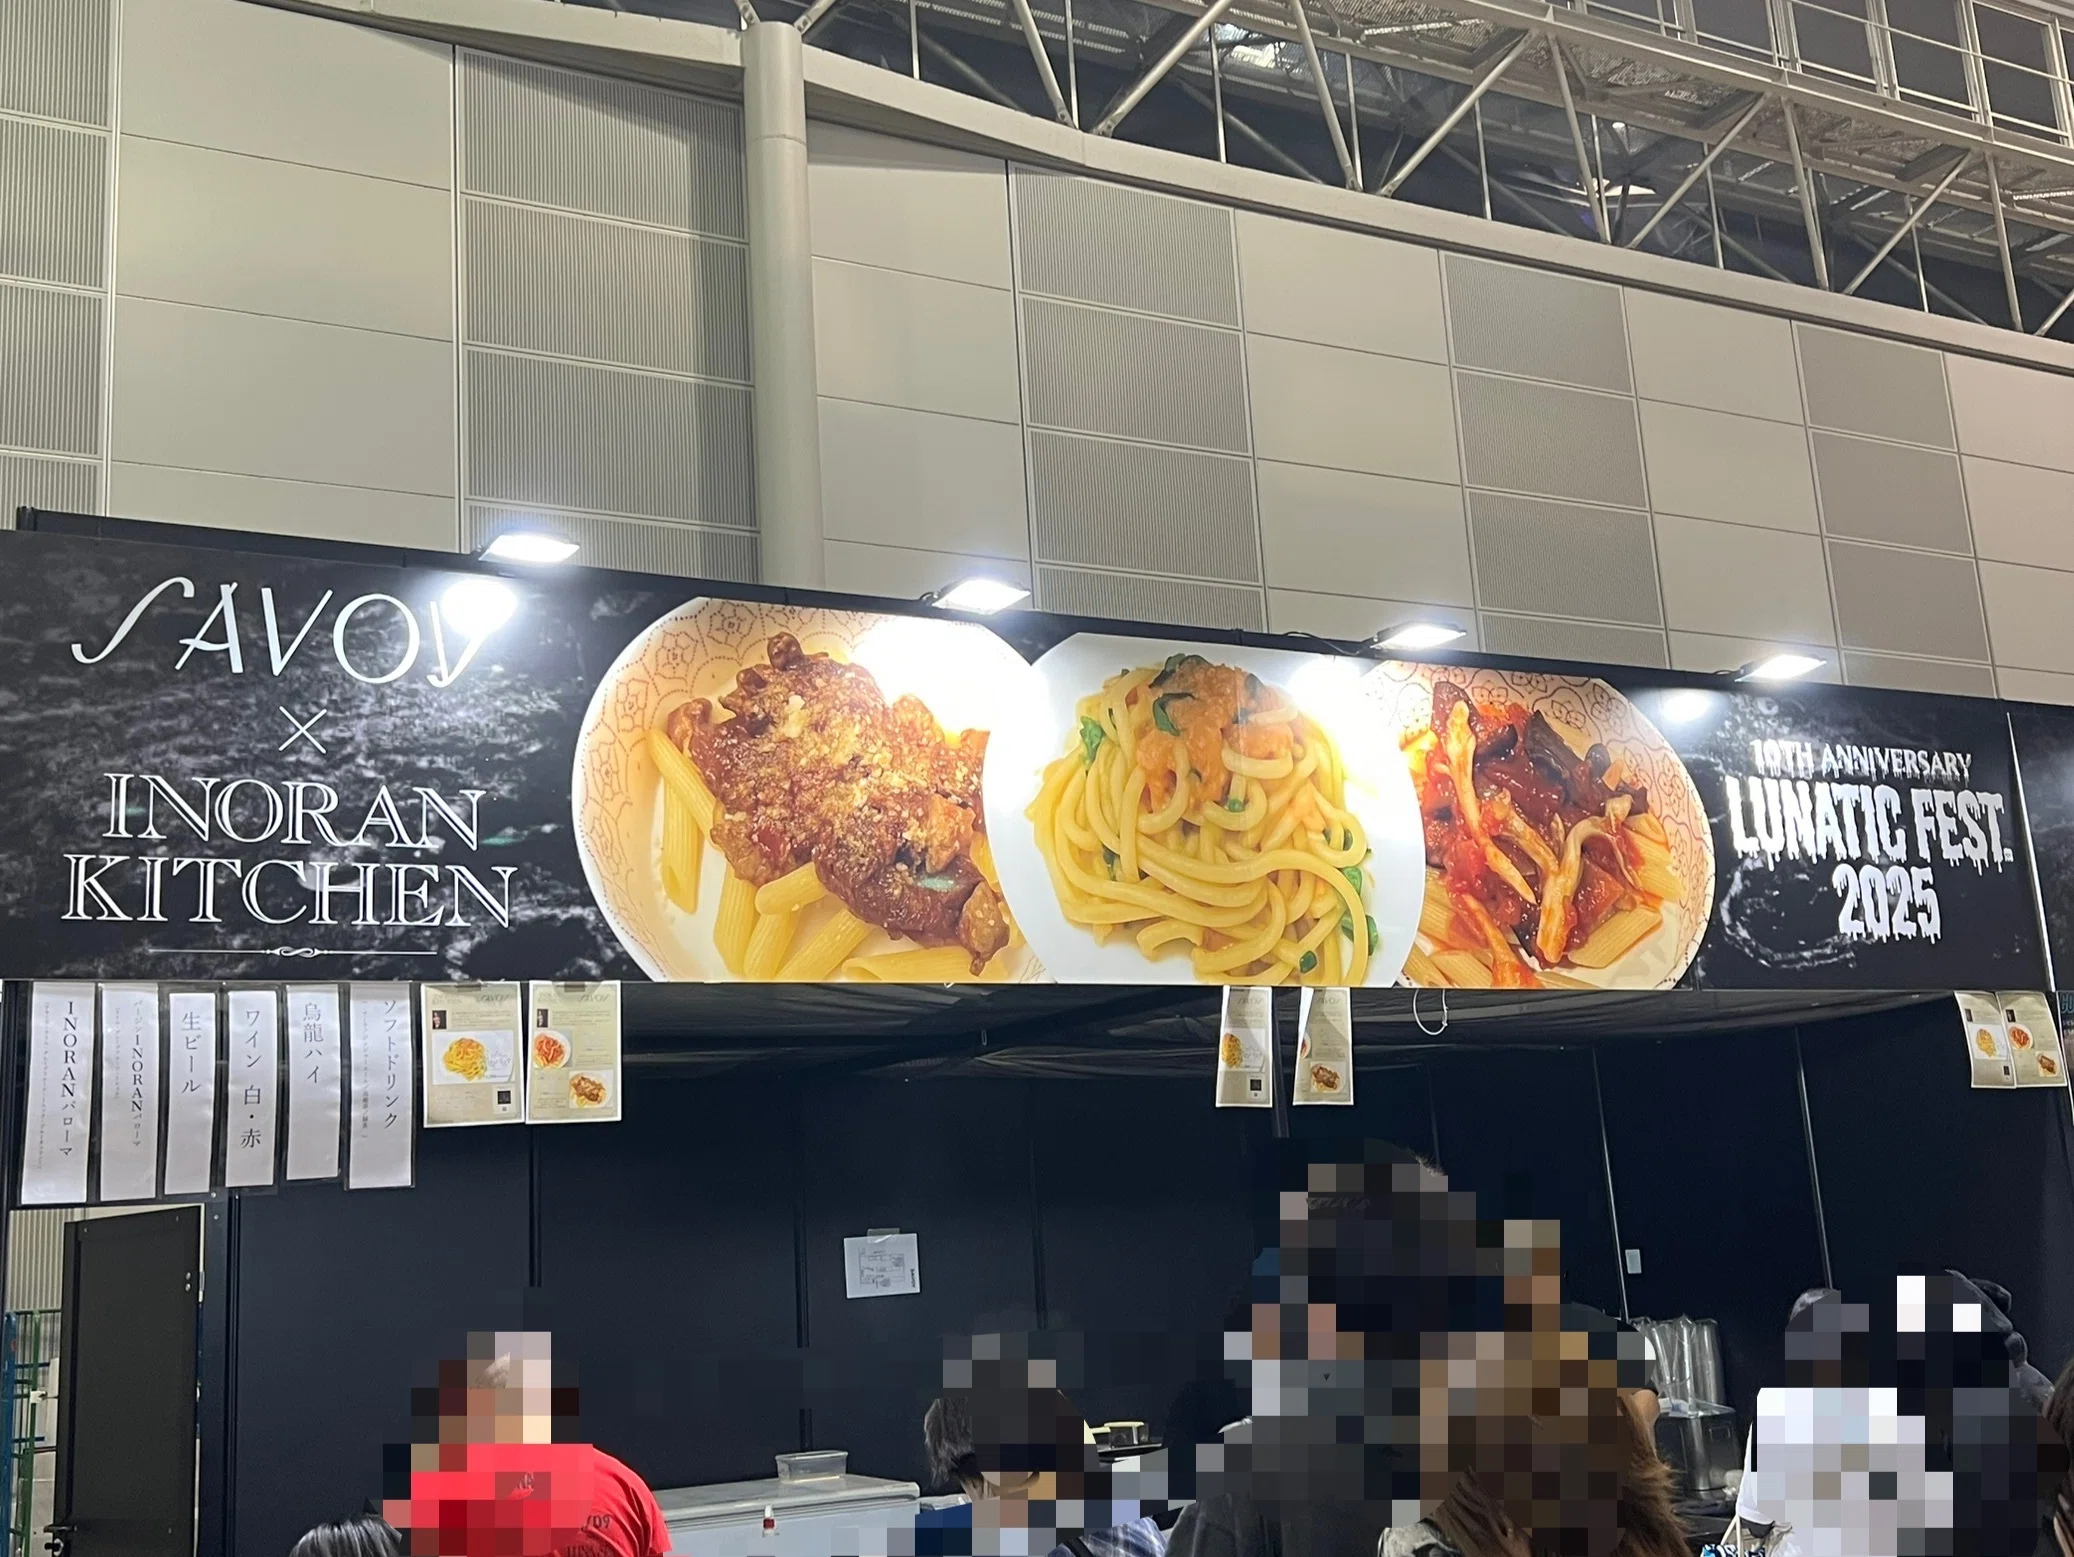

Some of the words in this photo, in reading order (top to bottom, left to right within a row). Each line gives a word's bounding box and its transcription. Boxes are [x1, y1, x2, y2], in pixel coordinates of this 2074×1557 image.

[70, 576, 503, 688] SAVOY
[1751, 739, 1814, 779] 10TH
[1821, 743, 1972, 787] ANNIVERSARY
[102, 772, 488, 851] INORAN
[1725, 775, 1907, 872] LUNATIC
[61, 853, 518, 928] KITCHEN
[1832, 863, 1942, 944] 2025
[180, 1011, 202, 1094] 生ビール
[244, 1009, 263, 1068] ワイン
[302, 1002, 324, 1084] 烏龍ハイ
[383, 1000, 400, 1129] ソフトドリンク
[241, 1084, 263, 1150] 白・赤
